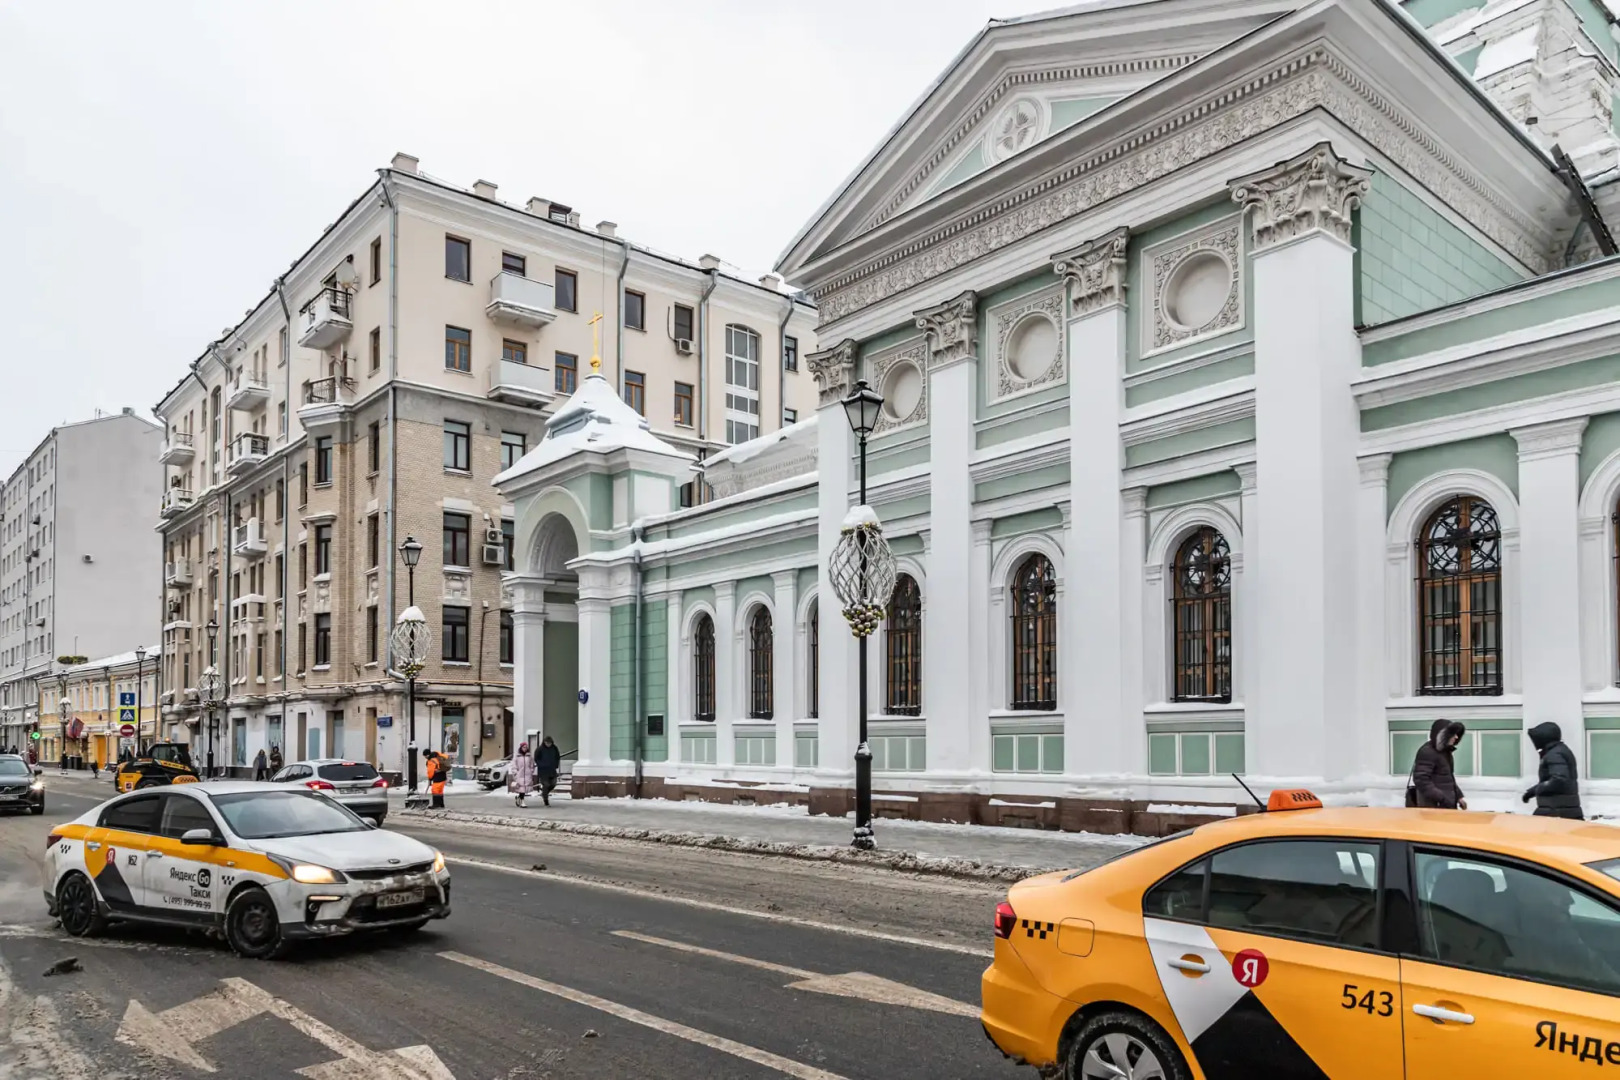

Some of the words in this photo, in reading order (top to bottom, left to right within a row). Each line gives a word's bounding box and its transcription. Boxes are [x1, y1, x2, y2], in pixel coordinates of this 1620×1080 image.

[170, 867, 197, 882] Яндекс
[198, 870, 210, 886] Go
[189, 885, 211, 899] Такси
[1240, 958, 1259, 984] Я
[1341, 984, 1394, 1017] 543
